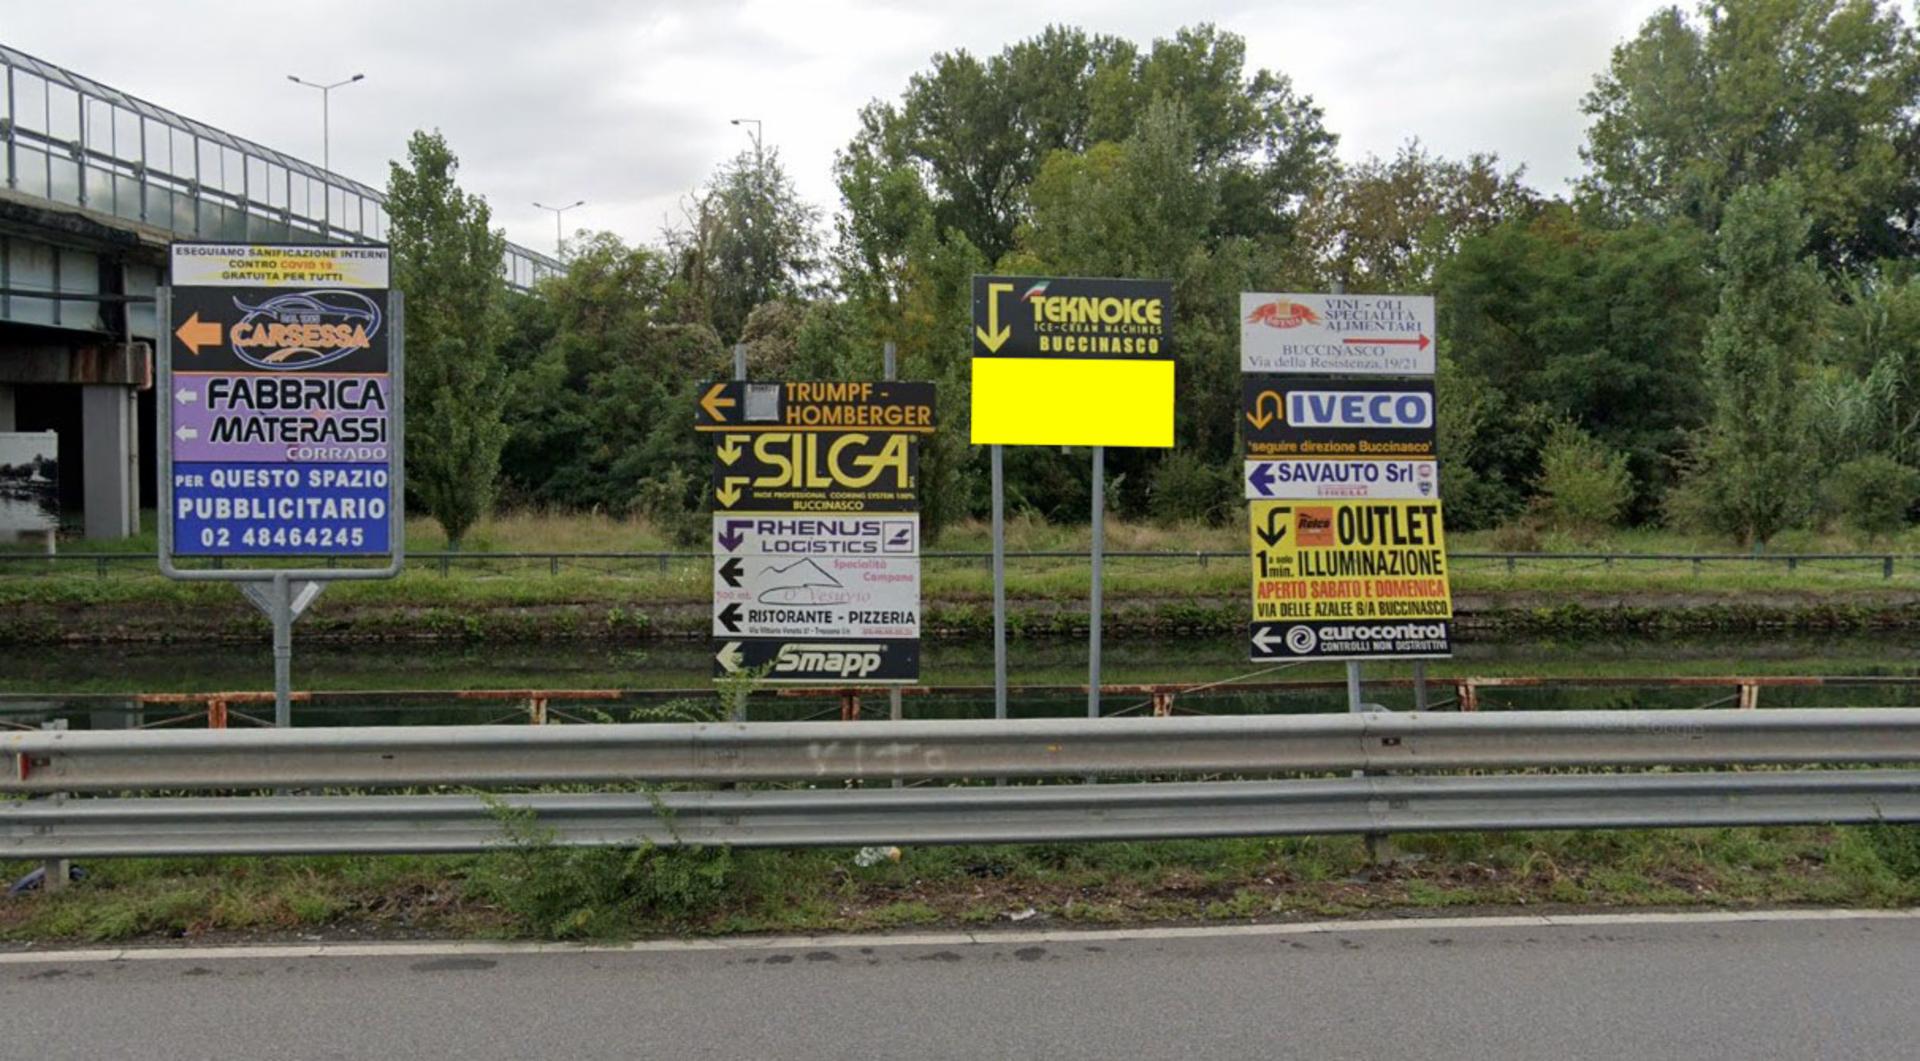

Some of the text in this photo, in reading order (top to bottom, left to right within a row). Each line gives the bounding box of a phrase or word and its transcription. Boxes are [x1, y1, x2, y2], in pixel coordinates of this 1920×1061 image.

[248, 248, 338, 259] SANIFICAZIONE
[340, 249, 387, 259] INTERNI
[228, 260, 333, 270] CONTRO COVID 19
[221, 271, 343, 282] GRATUITA PER TUTTI
[1030, 296, 1162, 324] TEKNOICE
[1325, 299, 1359, 310] VINI
[1376, 299, 1402, 311] OLI
[230, 322, 370, 348] CARSESSA
[1034, 323, 1163, 335] ICE-CREAM MACHINES
[1326, 320, 1422, 332] ALIMENTARI
[1039, 335, 1159, 354] BUCCINASCO
[1282, 344, 1386, 357] BUCCINASCO
[1249, 356, 1271, 367] Via
[1274, 356, 1306, 368] della
[207, 378, 386, 411] FABBRICA
[785, 382, 874, 402] TRUMPF
[786, 405, 931, 425] HOMBERGER
[1292, 395, 1427, 424] IVECO
[210, 416, 387, 443] MATERASSI
[286, 447, 387, 460] CORRADO
[1299, 440, 1357, 452] direzione
[752, 432, 909, 489] SILGA
[175, 469, 388, 488] PER QUESTO SPAZIO
[1278, 463, 1414, 482] SAVAUTO Srl
[178, 497, 386, 519] PUBBLICITARIO
[793, 500, 864, 511] BUCCINASCO
[757, 520, 881, 536] RHENUS
[1337, 505, 1438, 545] OUTLET
[201, 527, 364, 547] 02 48464245
[761, 540, 878, 553] LOGISTICS
[1256, 550, 1444, 578] 1 ILLUMINAZIONE
[1257, 579, 1446, 599] APERTO SABATO E DOMENICA
[748, 609, 833, 624] RISTORANTE
[849, 611, 916, 624] PIZZERIA
[1257, 602, 1277, 617] VIA
[1280, 602, 1311, 617] DELLE
[1315, 601, 1354, 617] AZALEE
[1379, 600, 1448, 616] BUCCINASCO
[1318, 623, 1446, 640] eurocontrol
[1320, 640, 1448, 651] CONTROLLI NON DISTRUTTIVI
[775, 643, 882, 678] Smapp
